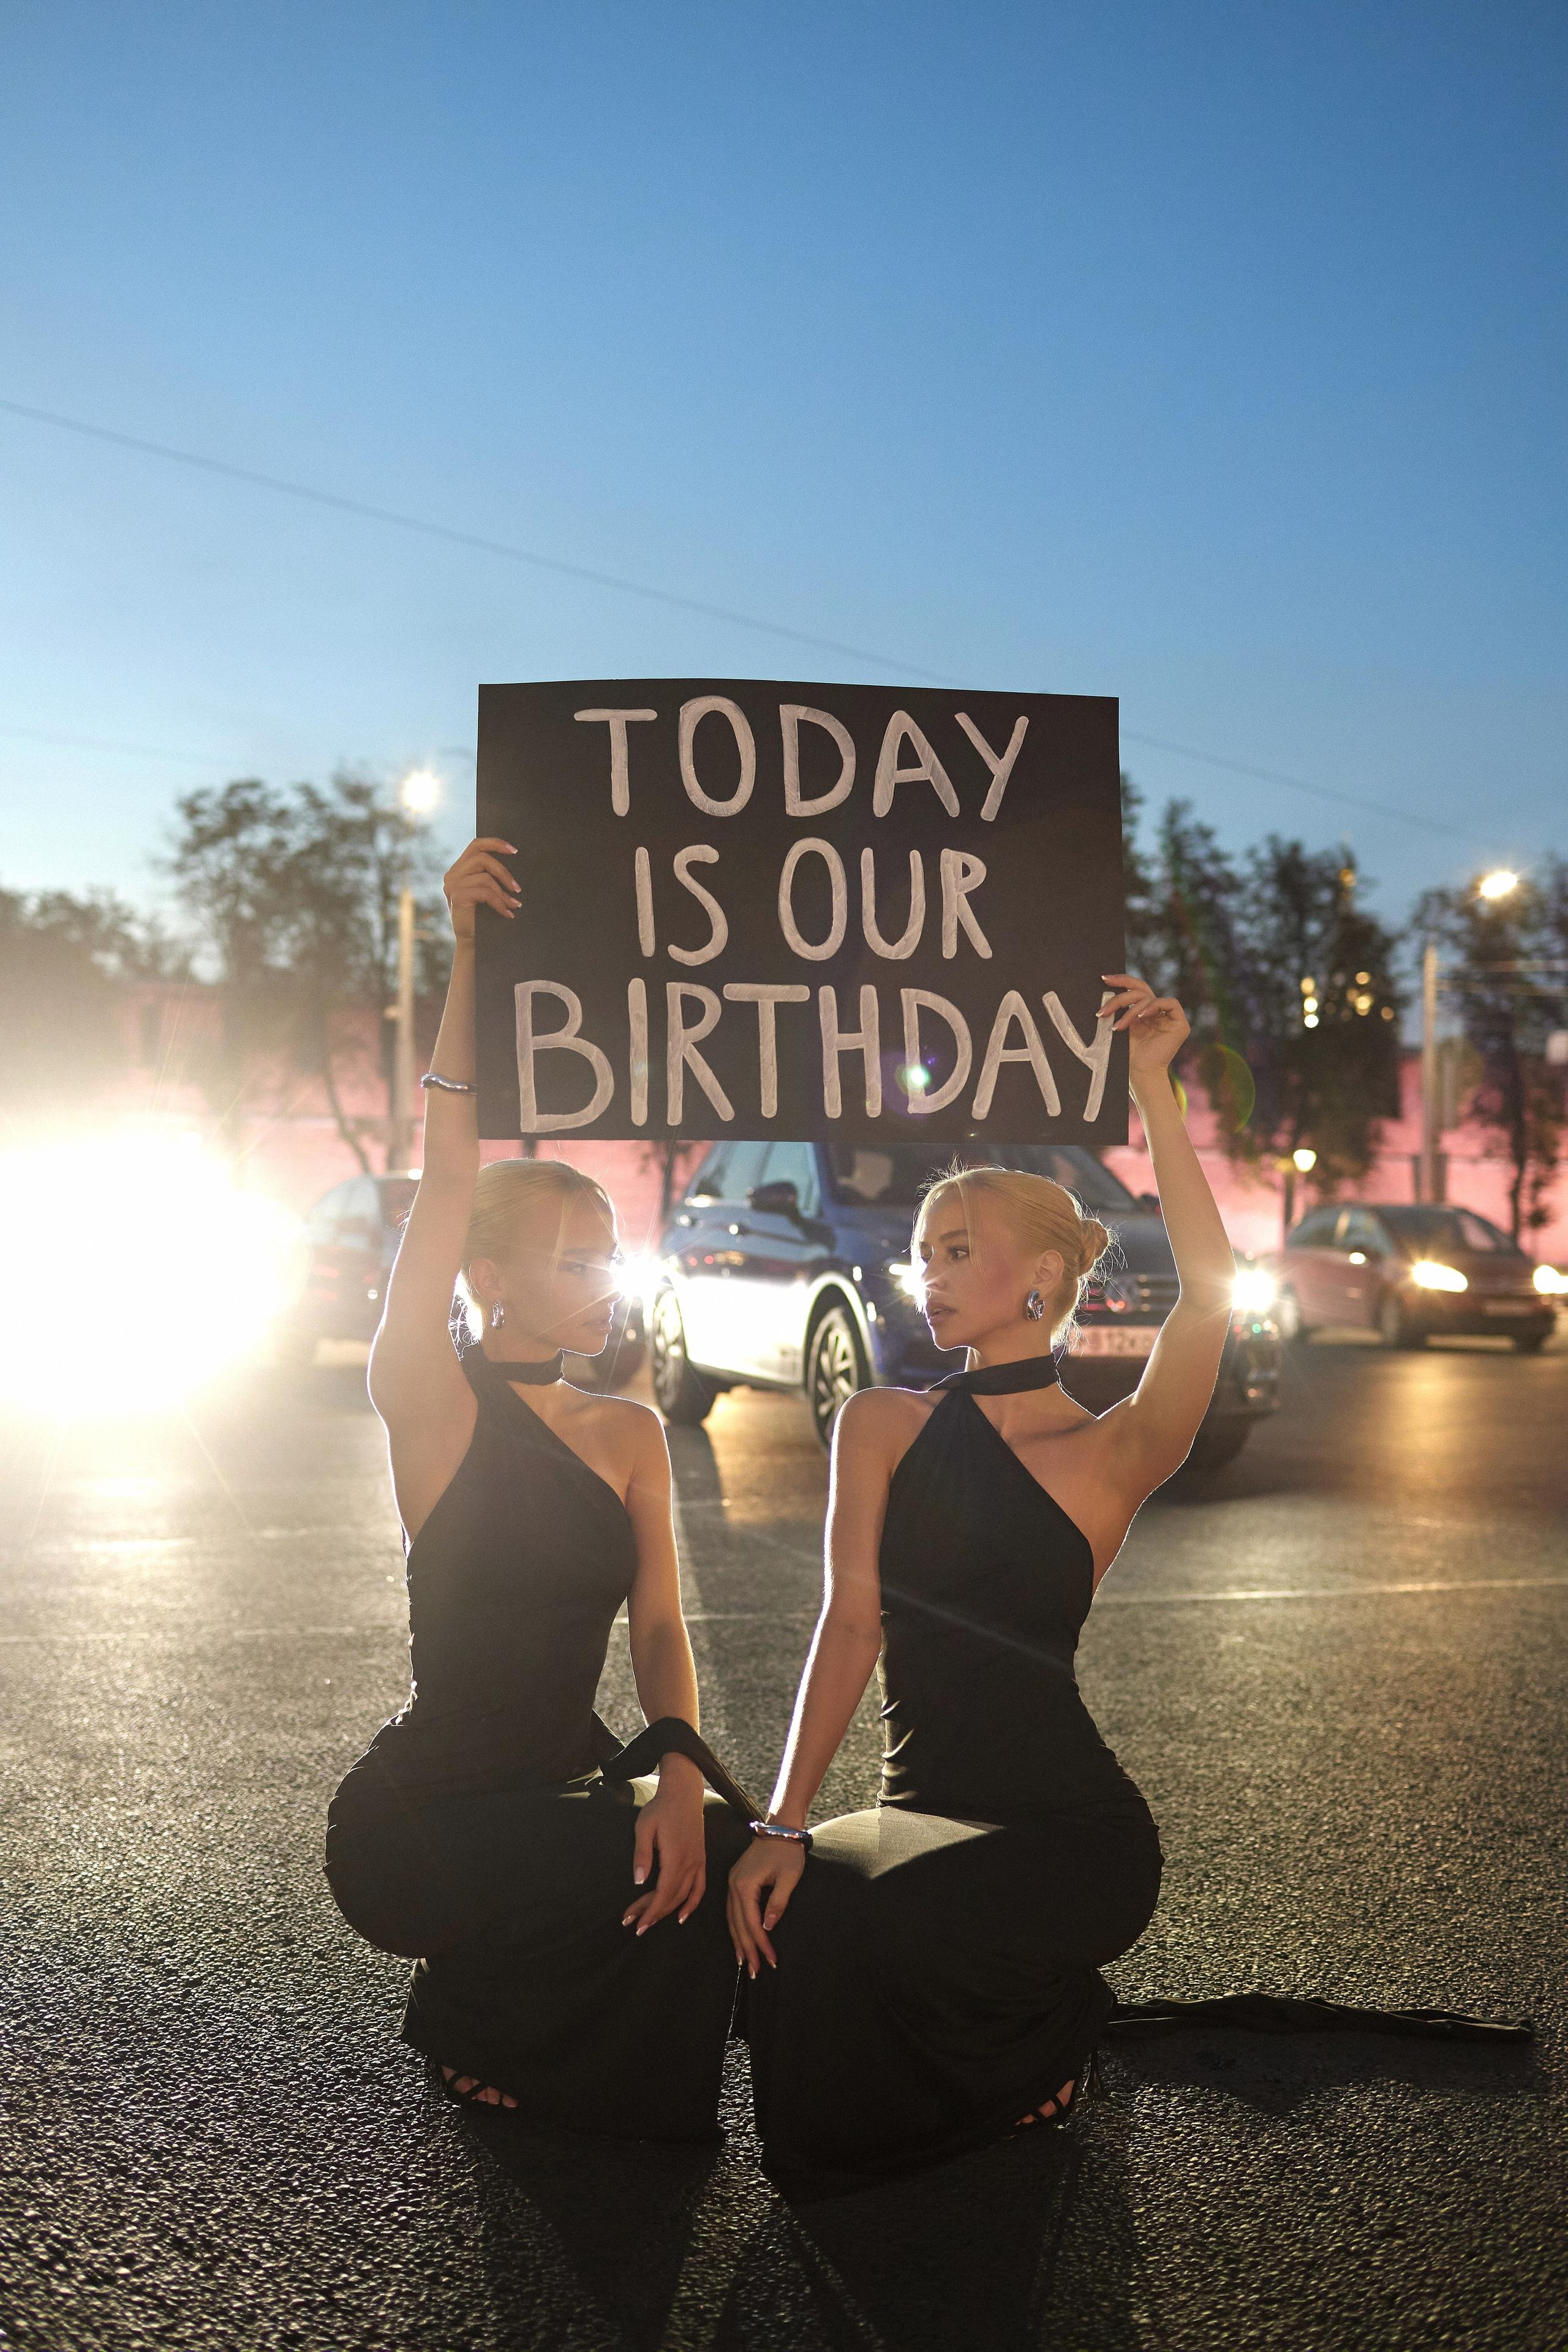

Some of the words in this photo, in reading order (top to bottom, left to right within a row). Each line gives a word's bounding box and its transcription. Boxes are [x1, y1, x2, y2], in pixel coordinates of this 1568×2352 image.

[574, 695, 1030, 822] TODAY
[634, 845, 729, 966] IS
[778, 837, 993, 961] OUR
[514, 978, 1115, 1133] BIRTHDAY
